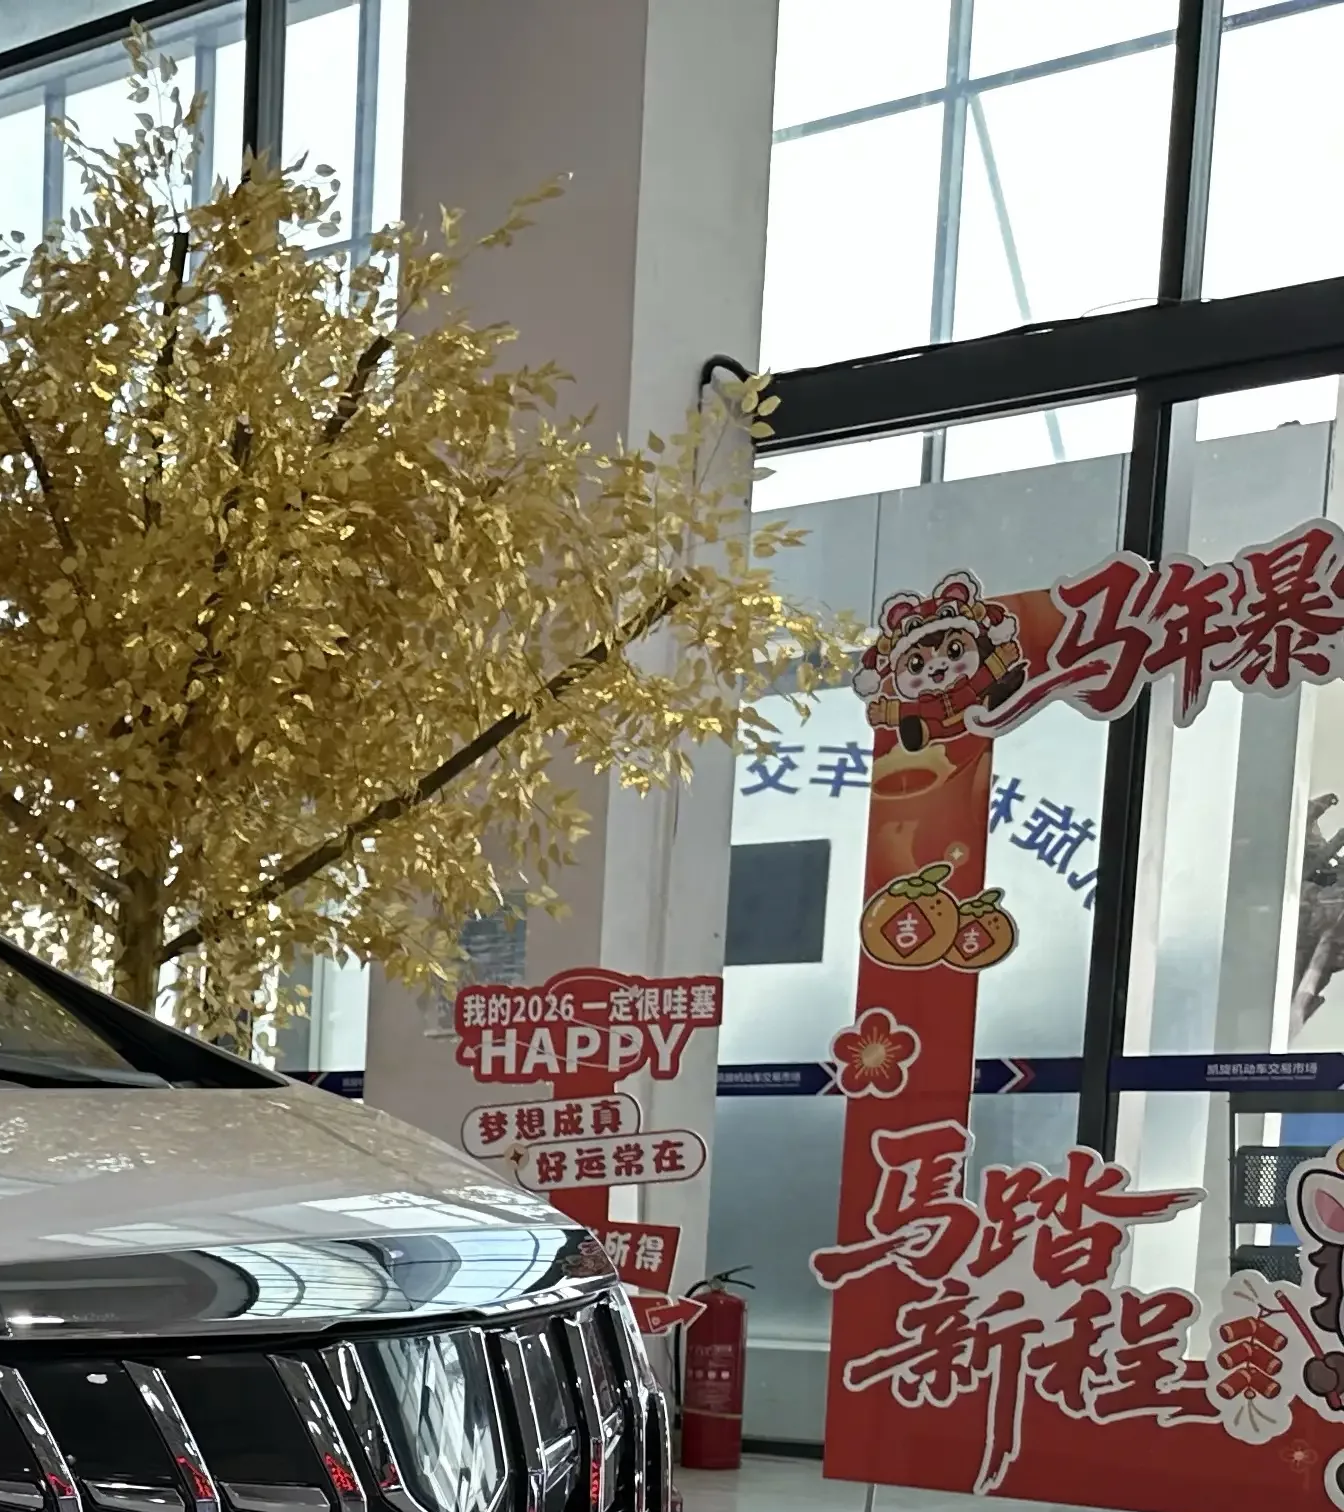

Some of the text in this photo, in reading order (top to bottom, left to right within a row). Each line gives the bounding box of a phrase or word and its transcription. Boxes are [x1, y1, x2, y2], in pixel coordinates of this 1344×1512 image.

[972, 528, 1344, 724] 马年暴
[896, 912, 920, 949] 吉
[962, 928, 980, 951] 吉
[480, 1023, 686, 1075] HAPPY
[477, 1099, 623, 1146] 梦想成真
[535, 1139, 686, 1185] 好运常在
